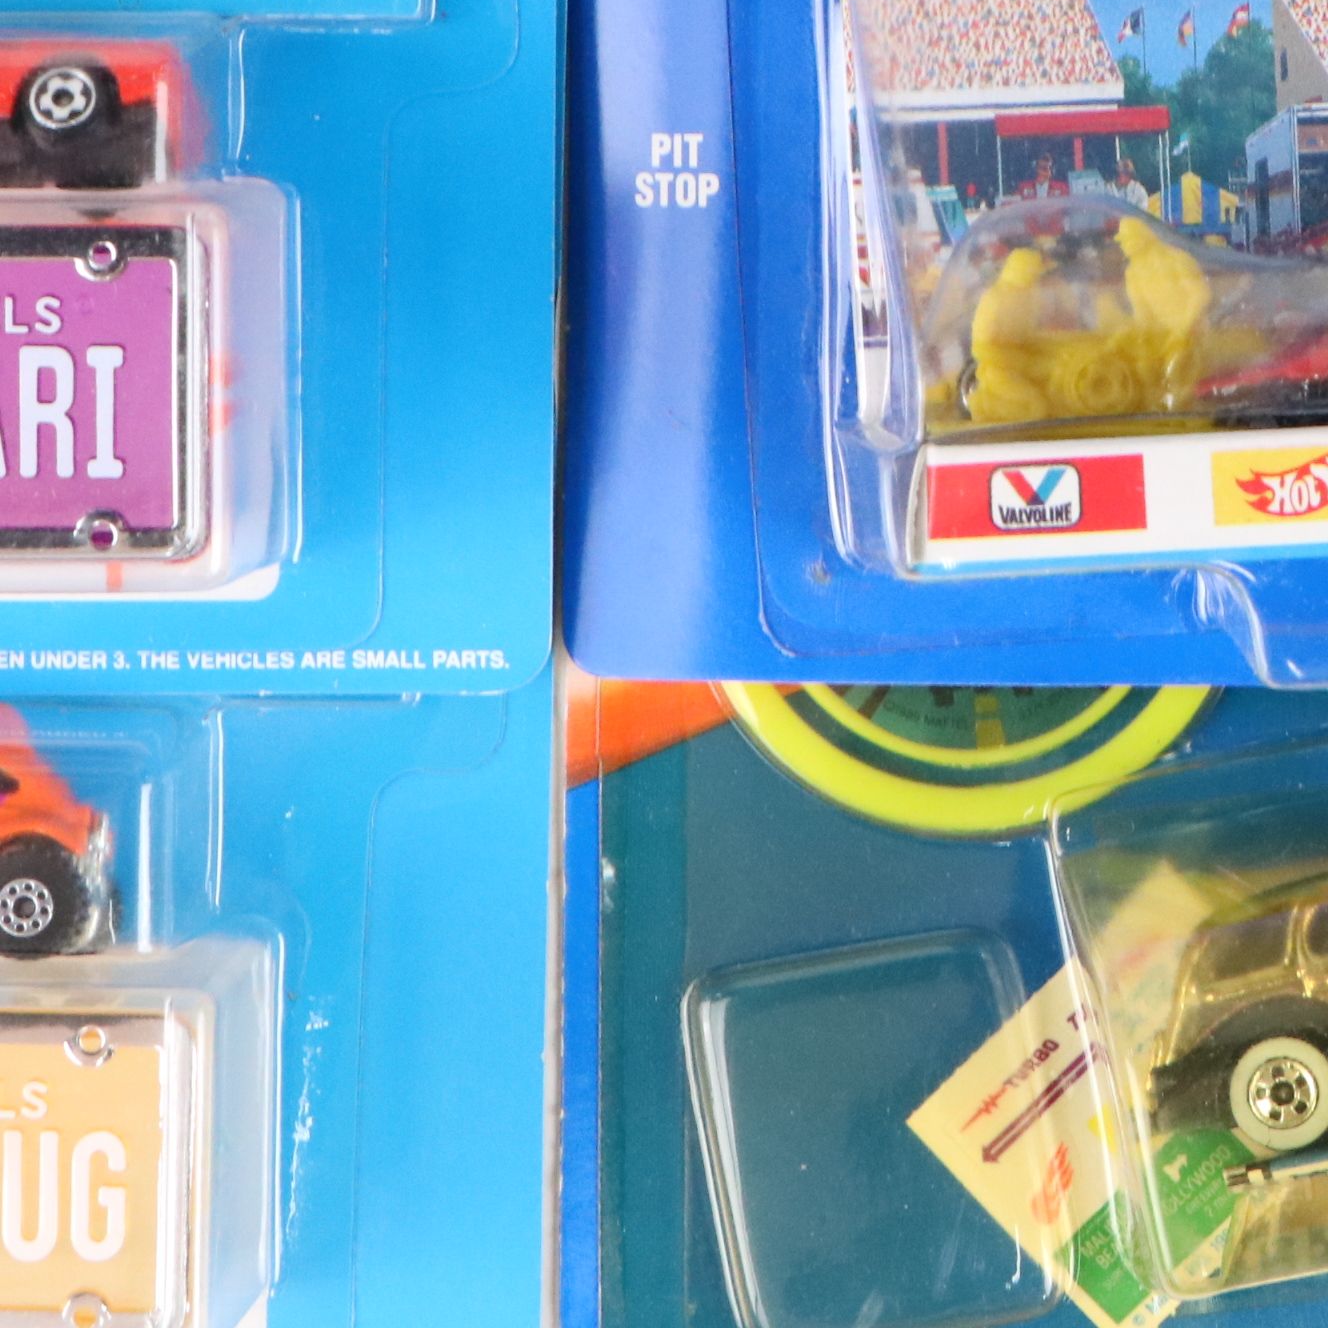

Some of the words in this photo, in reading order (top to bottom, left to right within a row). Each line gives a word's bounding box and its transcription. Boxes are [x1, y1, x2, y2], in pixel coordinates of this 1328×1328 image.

[651, 133, 703, 168] PIT
[634, 173, 719, 208] STOP
[5, 296, 62, 334] LS
[0, 345, 124, 479] RI
[999, 502, 1072, 524] VALVOLINE
[0, 650, 24, 670] EN
[31, 650, 107, 670] UNDER
[113, 650, 131, 670] 3.
[137, 650, 180, 670] THE
[187, 651, 295, 670] VEHICLES
[301, 650, 346, 670] ARE
[352, 649, 426, 669] SMALL
[433, 649, 510, 669] PARTS.
[2, 1130, 126, 1262] UG
